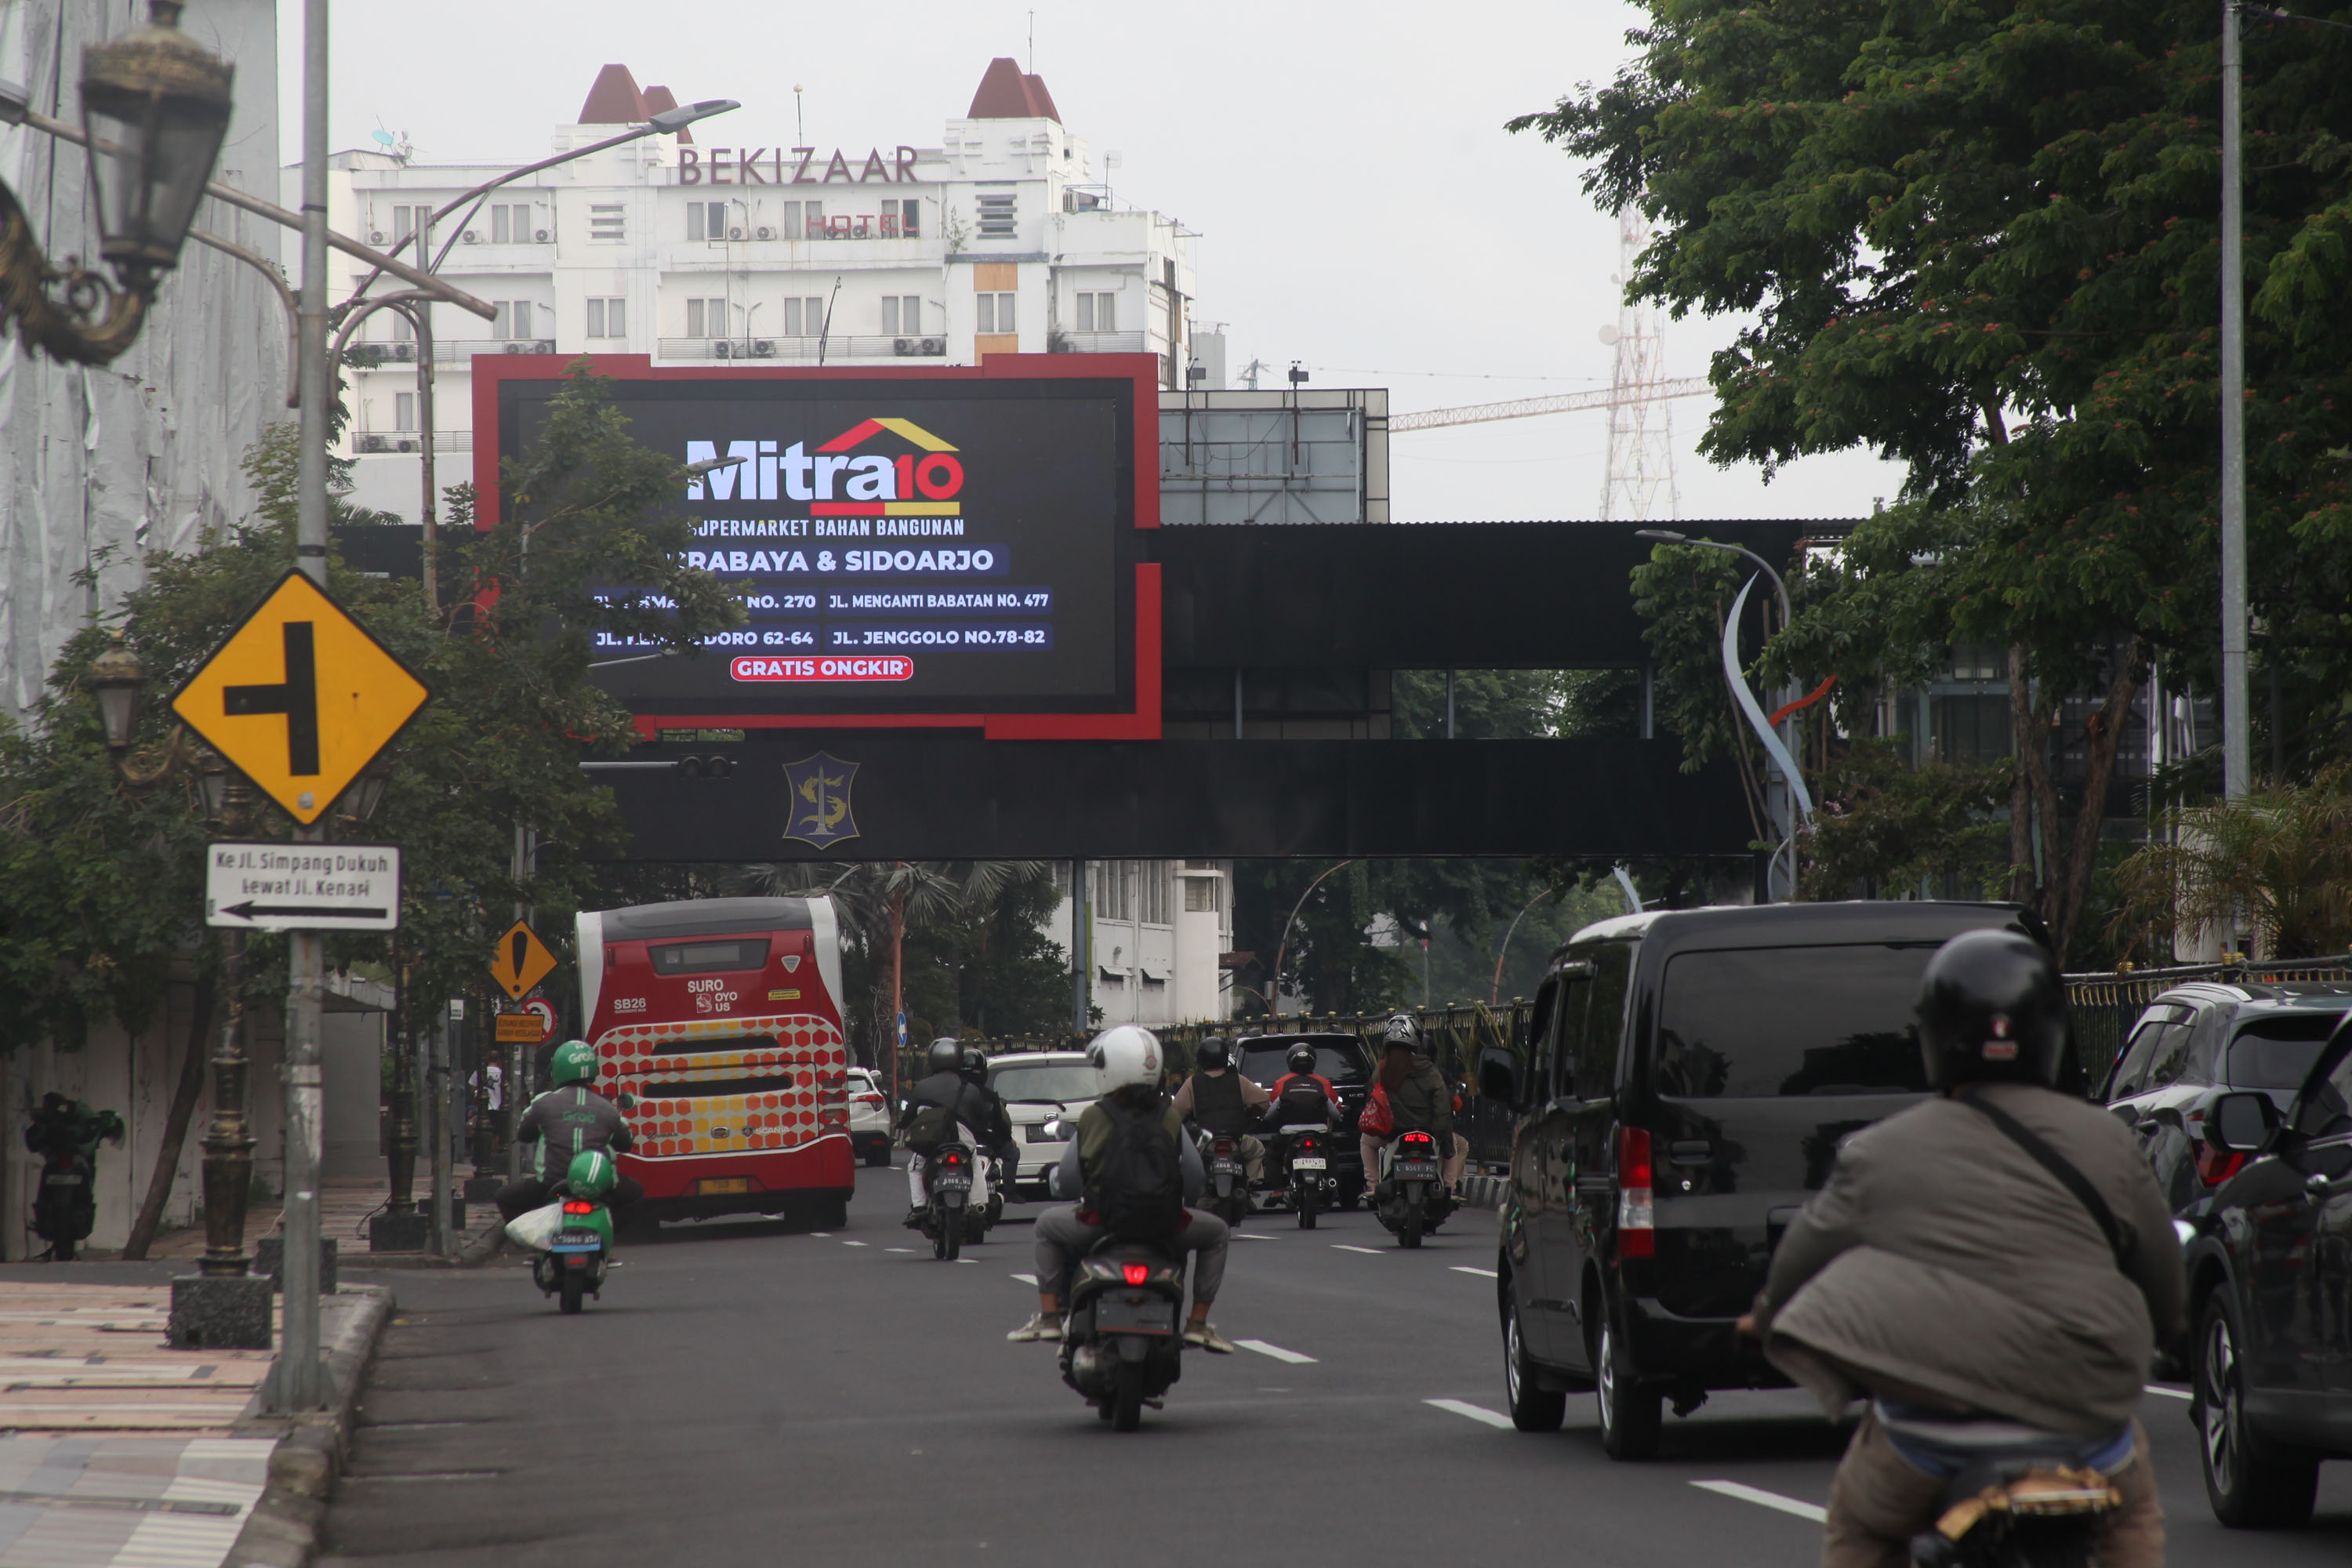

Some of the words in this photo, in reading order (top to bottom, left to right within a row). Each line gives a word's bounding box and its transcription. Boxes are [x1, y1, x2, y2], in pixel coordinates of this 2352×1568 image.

[679, 146, 919, 185] BEKIZAAR
[807, 214, 920, 232] HOTEL
[687, 441, 964, 500] Mitra10
[815, 519, 870, 536] BAHAN
[876, 519, 964, 536] BANGUNAN
[666, 550, 809, 572] RABAYA
[817, 550, 837, 572] &
[845, 550, 994, 572] SIDOARJO
[746, 595, 779, 608] NO.
[784, 595, 815, 608] 270
[829, 595, 848, 608] JL.
[852, 594, 924, 608] MENGANTI
[927, 594, 993, 608] BABATAN
[997, 593, 1020, 608] NO.
[1024, 593, 1049, 607] 477
[597, 633, 622, 645] JL.
[763, 632, 813, 645] 62-64
[833, 631, 858, 644] JL.
[863, 630, 959, 644] JENGGOLO
[964, 630, 1045, 644] NO.78-82
[737, 660, 815, 676] GRATIS
[216, 852, 234, 868] Ke
[260, 852, 332, 875] Simpang
[336, 855, 388, 872] Dukuh
[241, 879, 290, 895] Lewat
[316, 880, 370, 897] Kenari
[688, 979, 724, 993] SURO
[614, 998, 646, 1009] SB26
[568, 1051, 596, 1064] Grab
[563, 1109, 596, 1123] Grab
[755, 1126, 790, 1135] SCANIA
